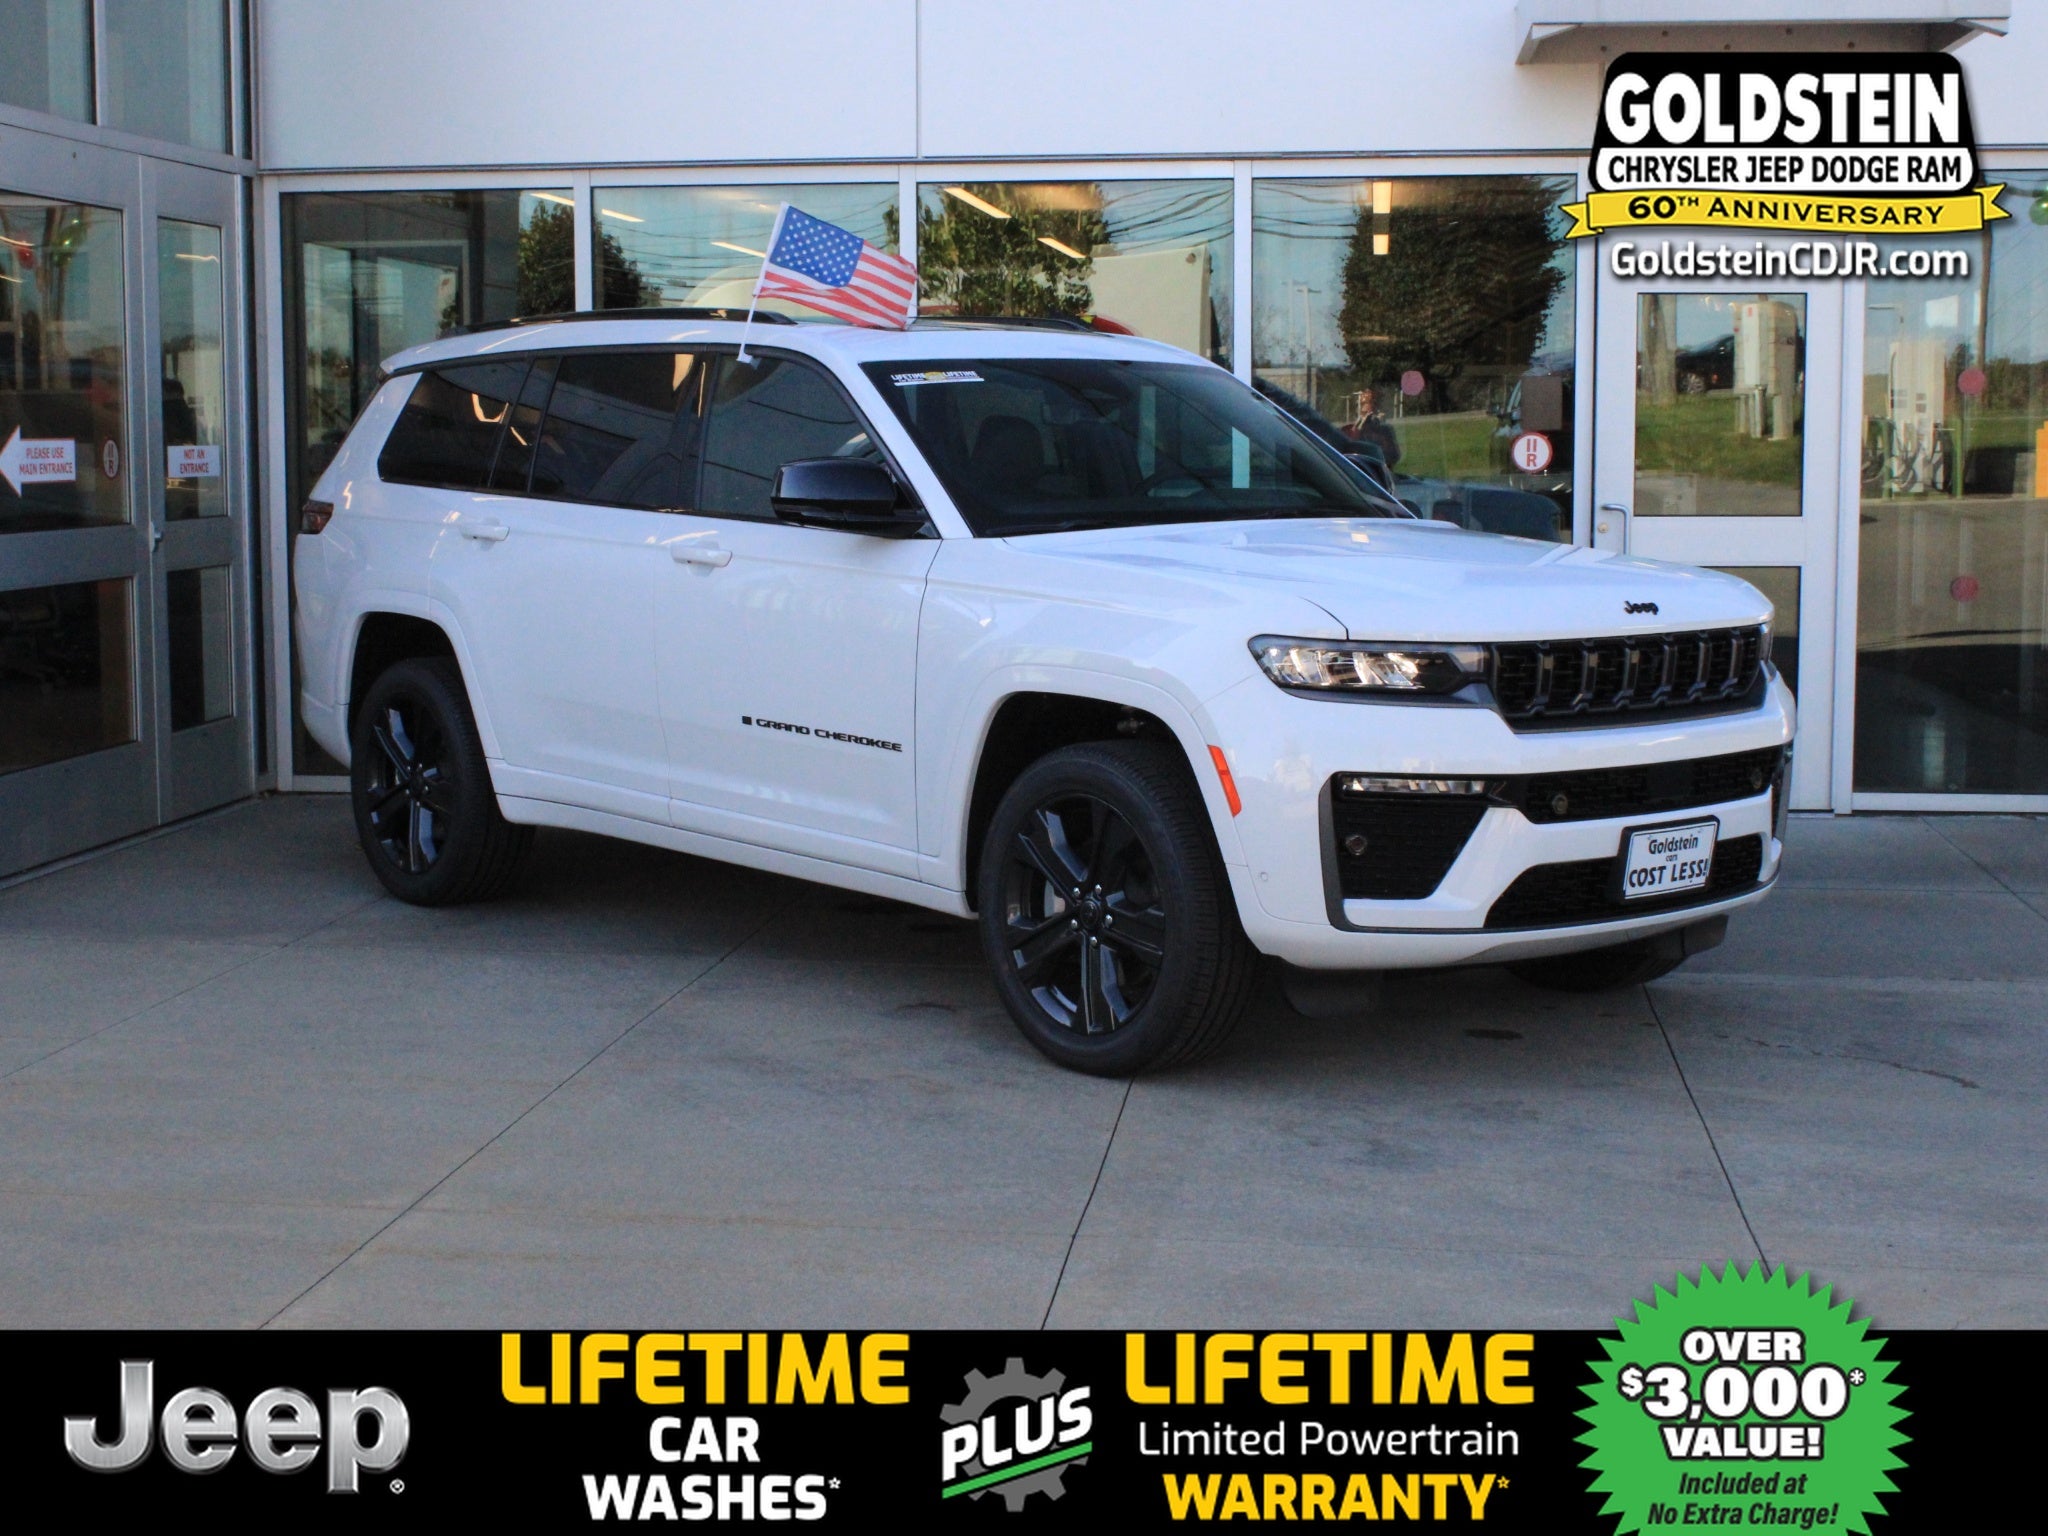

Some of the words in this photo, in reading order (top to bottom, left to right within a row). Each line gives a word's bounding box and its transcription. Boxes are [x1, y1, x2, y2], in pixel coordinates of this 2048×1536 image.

[26, 447, 50, 459] PLEASE
[52, 447, 64, 459] USE
[184, 449, 195, 459] NOT
[19, 463, 38, 475] MAIN
[39, 462, 72, 475] ENTRANCE
[180, 462, 209, 474] ENTRANCE
[1624, 600, 1659, 615] Jeep
[756, 718, 811, 735] GRAND
[814, 728, 903, 752] CHEROKEE
[1649, 835, 1698, 854] Goldstein
[1665, 854, 1678, 862] cars
[1628, 865, 1667, 888] COST
[1670, 858, 1708, 882] LESS!
